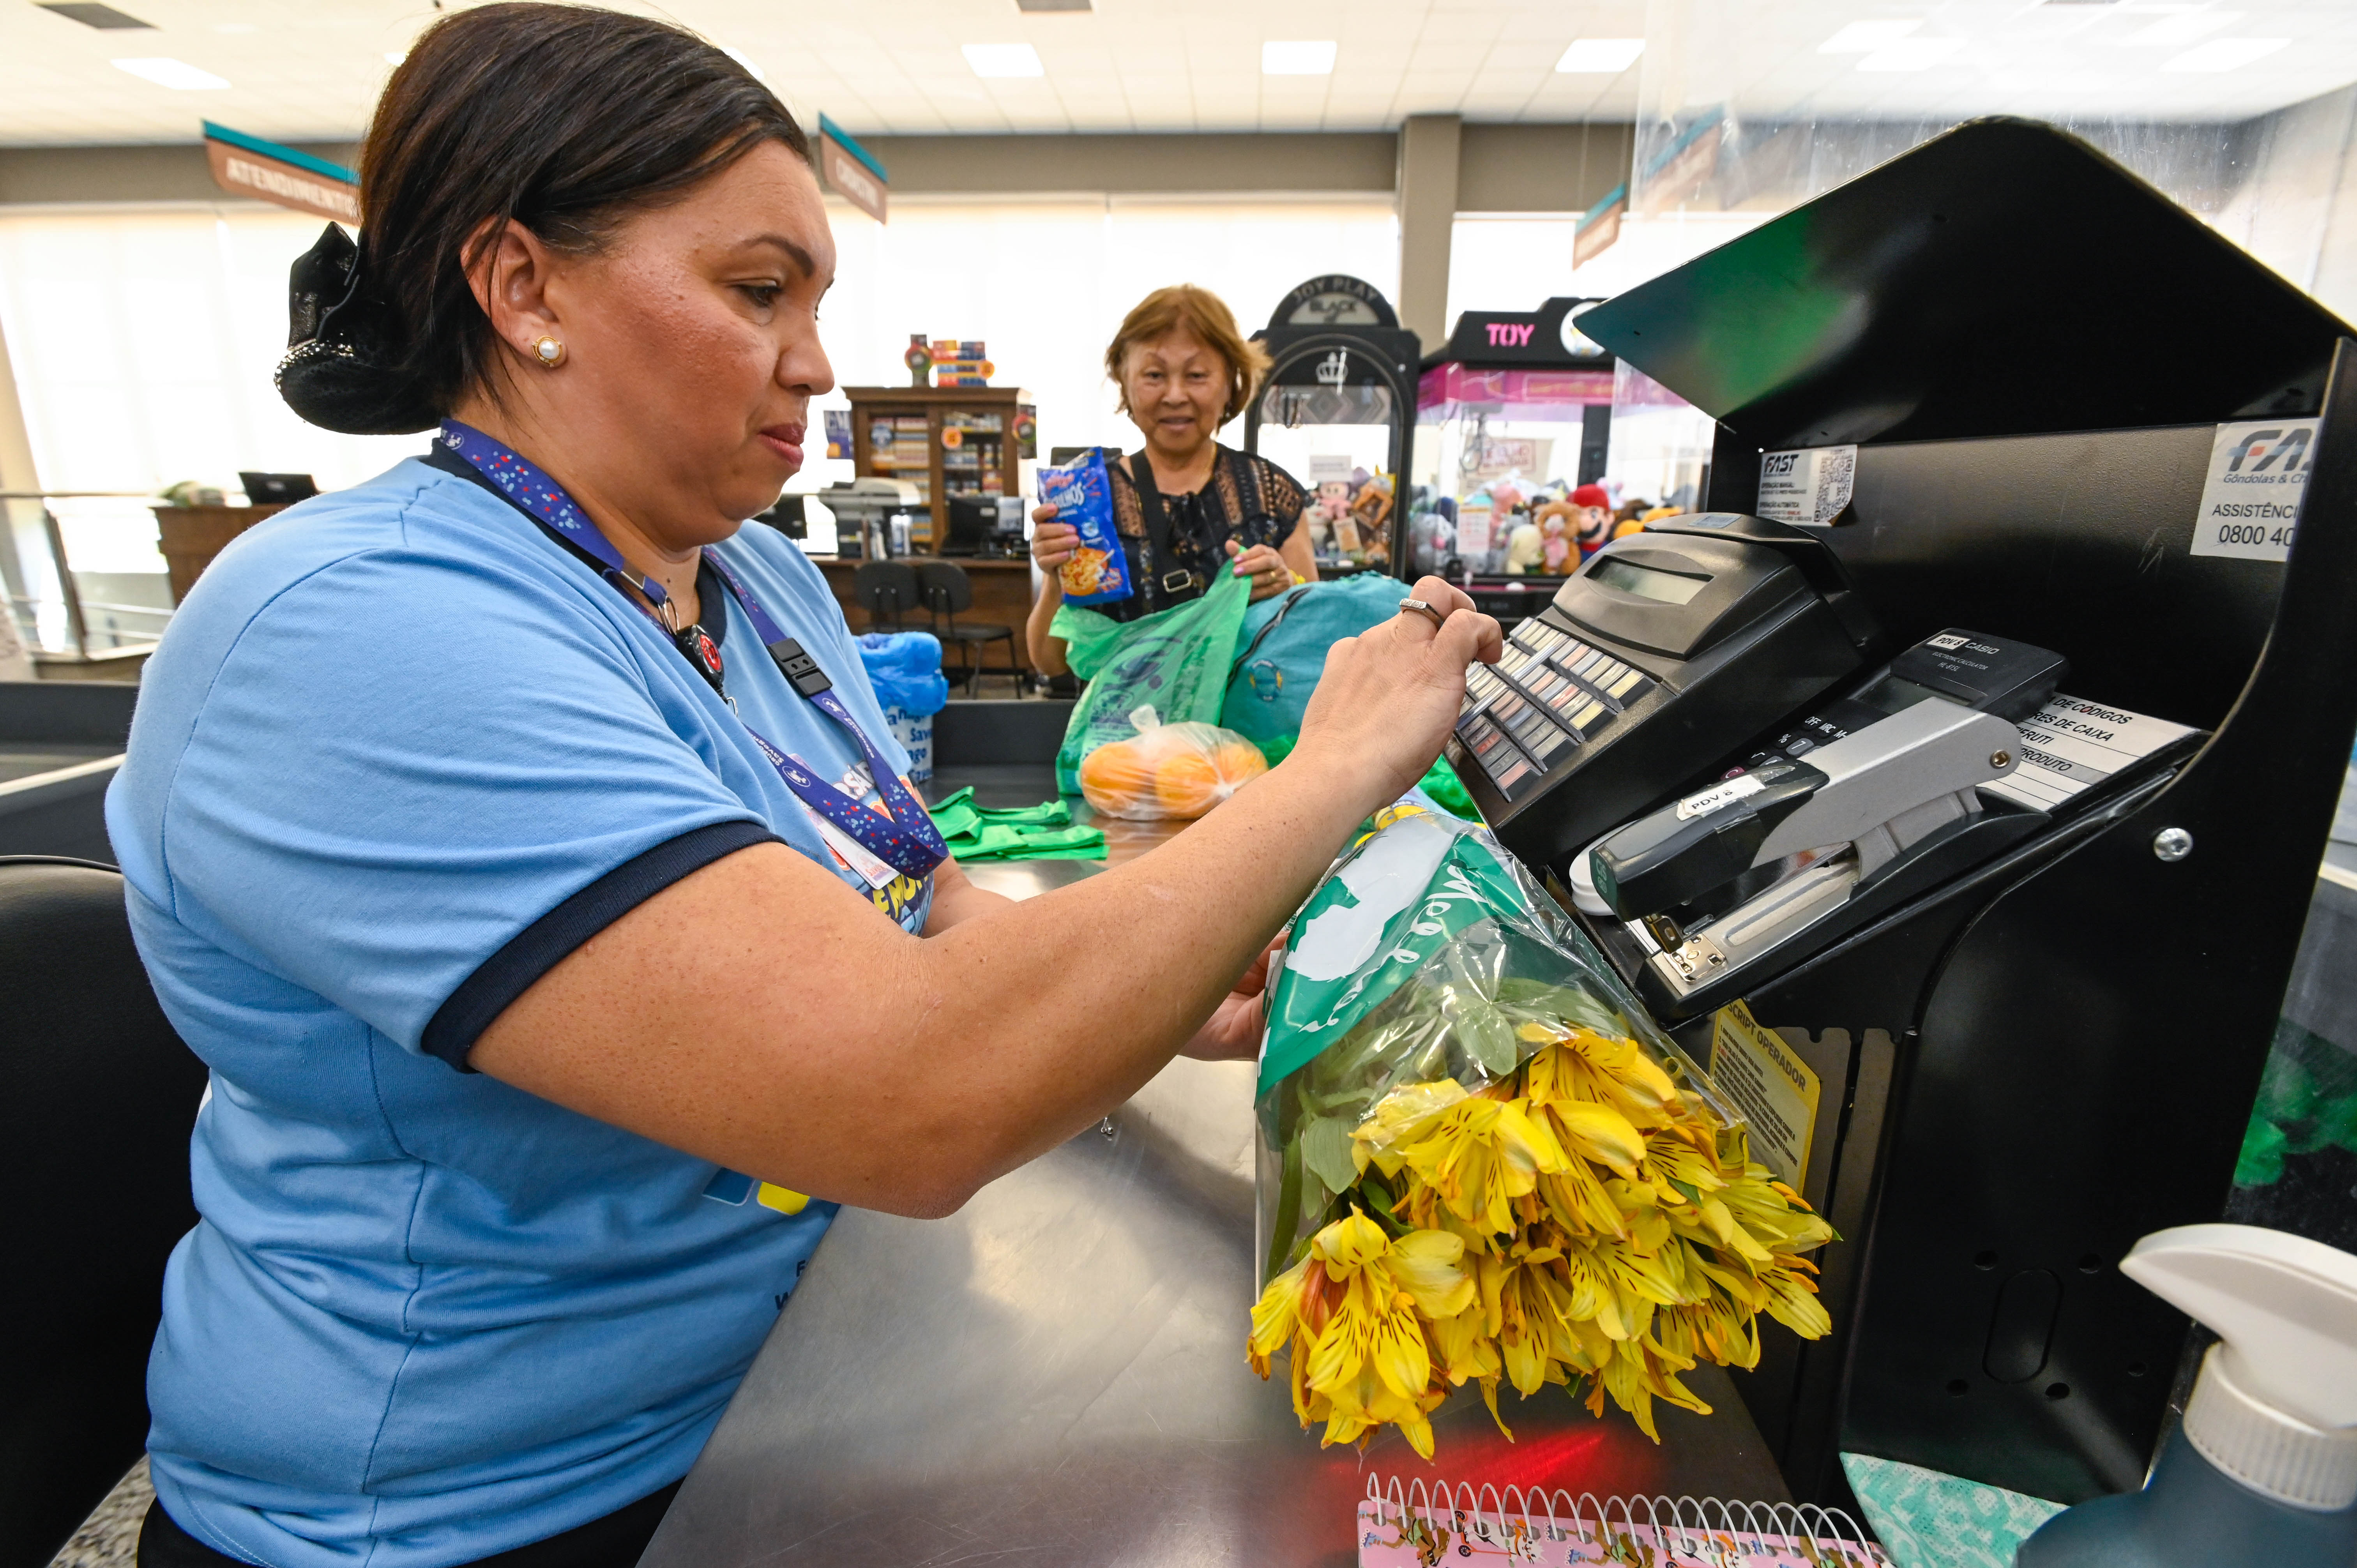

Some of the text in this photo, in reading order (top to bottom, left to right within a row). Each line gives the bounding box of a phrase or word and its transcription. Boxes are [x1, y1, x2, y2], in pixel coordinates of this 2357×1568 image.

[1486, 323, 1535, 346] TOY
[1764, 454, 1800, 473] FAST
[2224, 473, 2276, 484] Gôndolas
[2219, 524, 2265, 544] 0800
[1965, 642, 2000, 654] CASIO
[1932, 652, 1989, 670] ELECTRONIC CALCULATOR
[2053, 698, 2075, 708] DE
[2071, 705, 2133, 724] CÓDIGOS
[1805, 716, 1822, 726] OFF
[1818, 723, 1836, 733] MRC
[2053, 719, 2076, 729] DE
[2072, 724, 2114, 741] CAIXA
[2021, 748, 2072, 771] PRODUTO
[1691, 794, 1719, 809] PDV
[1728, 1003, 1756, 1035] SCRIPT
[1757, 1030, 1806, 1092] OPERADOR
